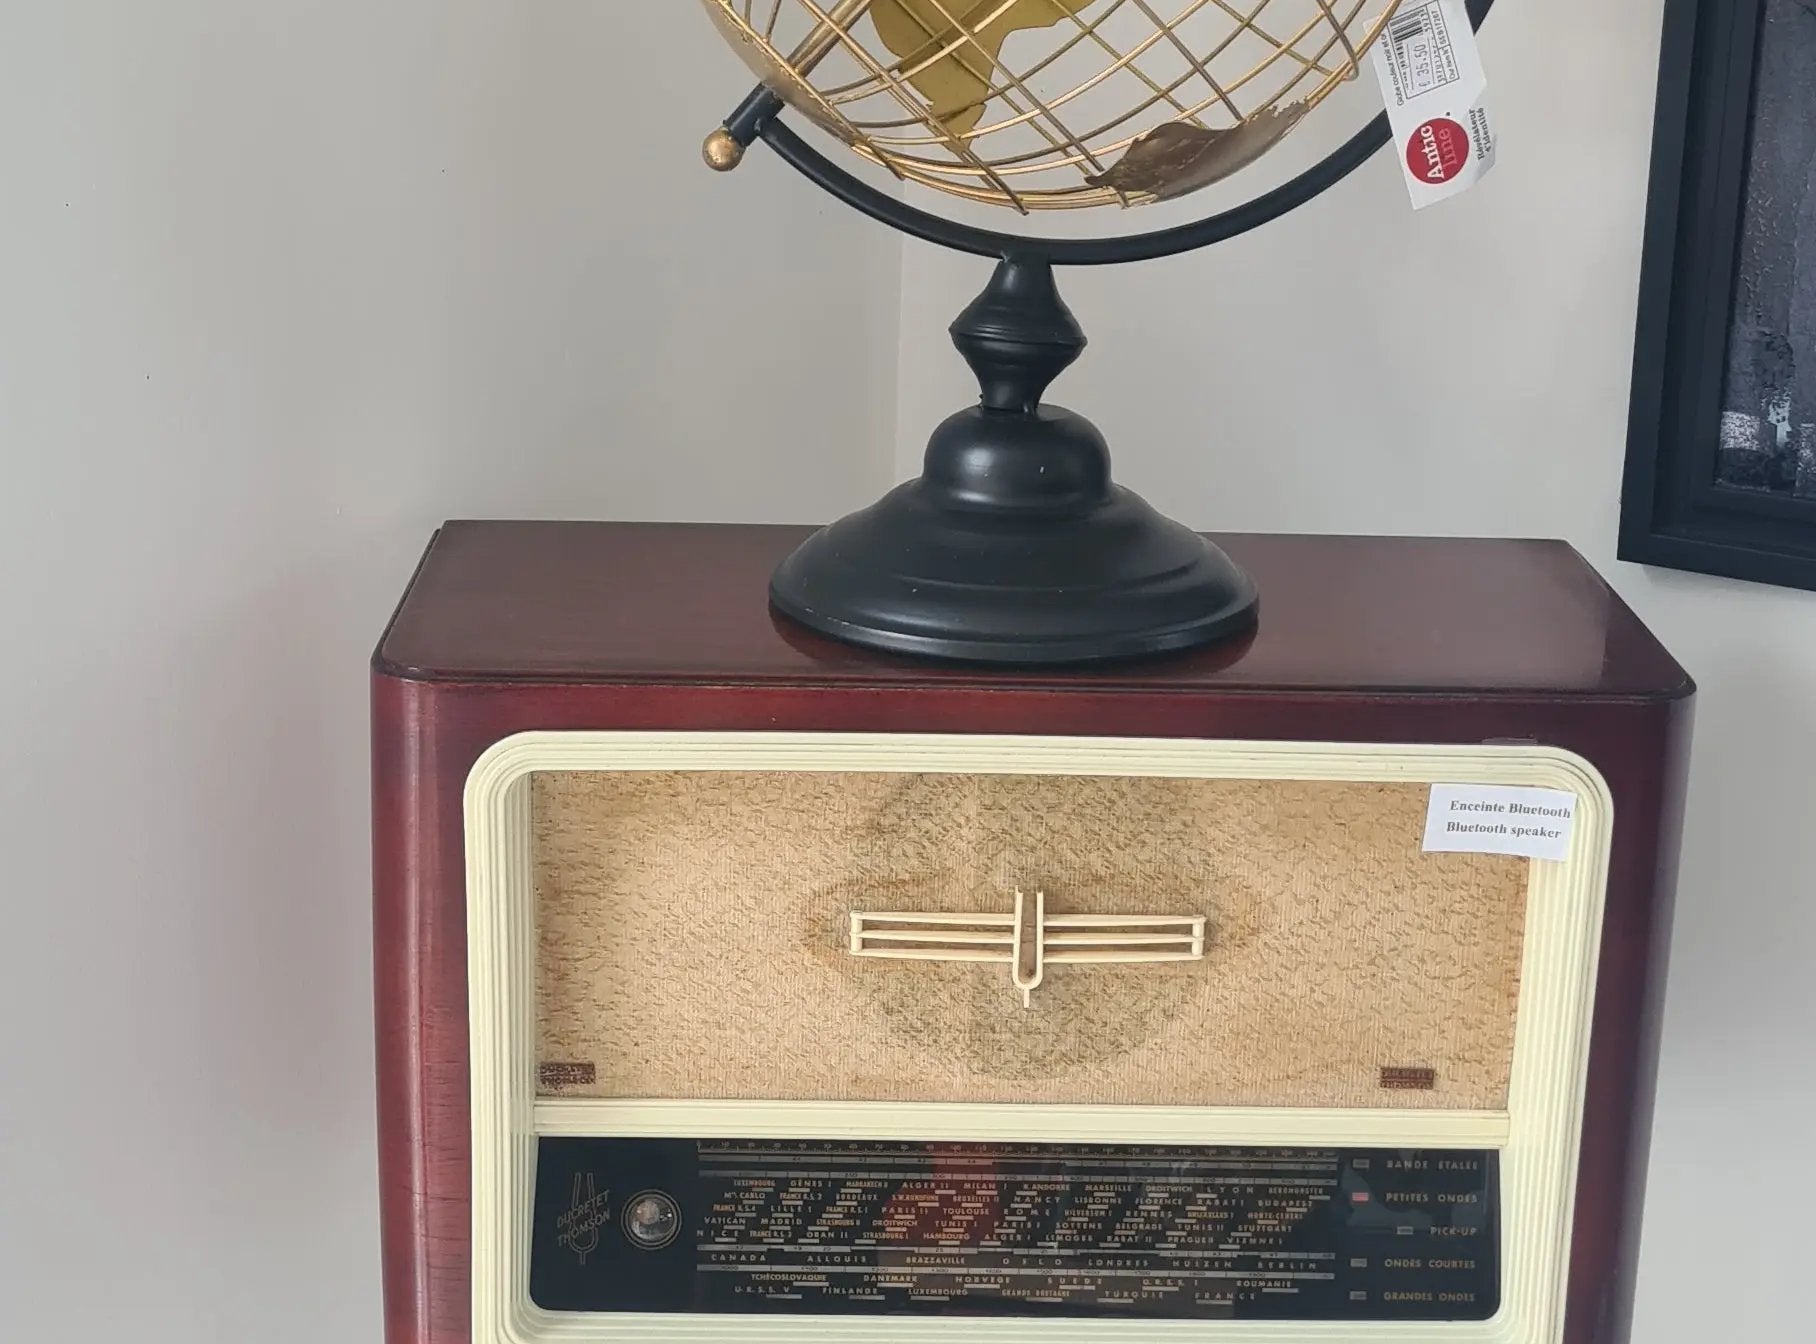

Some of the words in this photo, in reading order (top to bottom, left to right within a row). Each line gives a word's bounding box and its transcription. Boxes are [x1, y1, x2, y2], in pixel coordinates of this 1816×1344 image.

[1414, 44, 1430, 77] 35.50
[1421, 125, 1445, 179] Antic
[1450, 800, 1504, 813] Enceinte
[1509, 803, 1571, 818] Bluetooth
[1447, 822, 1507, 834] Bluetooth
[1510, 827, 1561, 838] speaker
[1387, 1159, 1428, 1169] BANDE
[1085, 1184, 1131, 1192] MARSEILLE
[1146, 1185, 1192, 1193] DROITWICH
[1386, 1192, 1428, 1202] PETITES
[1438, 1193, 1477, 1203] ONDES
[1258, 1199, 1312, 1207] BUDAPEST
[557, 1189, 610, 1228] DUCRETET
[771, 1205, 802, 1213] LILLE
[704, 1217, 746, 1225] VATICAN
[761, 1217, 802, 1225] MADRID
[935, 1220, 967, 1228] TUNIS
[558, 1208, 610, 1246] THOMSON
[1430, 1226, 1477, 1235] PICK-UP
[923, 1232, 970, 1240] HAMBOURG
[1046, 1234, 1092, 1242] LIMOGES
[807, 1255, 866, 1263] ALLOUIS
[906, 1256, 965, 1265] BRAZZAVILLE
[1003, 1258, 1062, 1266] OSLO
[1088, 1258, 1149, 1267] LONDRES
[1258, 1262, 1316, 1270] BERLIN
[1384, 1258, 1421, 1268] ONDES
[1429, 1259, 1475, 1269] COURTES
[864, 1274, 918, 1282] DANEMARK
[1236, 1280, 1291, 1288] ROUMANIE
[823, 1287, 877, 1295] FINLANDE
[909, 1288, 968, 1296] LUXEMBOURG
[1105, 1291, 1163, 1299] TURQUIE
[1195, 1292, 1255, 1300] FRANCE
[1384, 1291, 1432, 1301] GRANDES
[1439, 1292, 1475, 1302] ONDES
